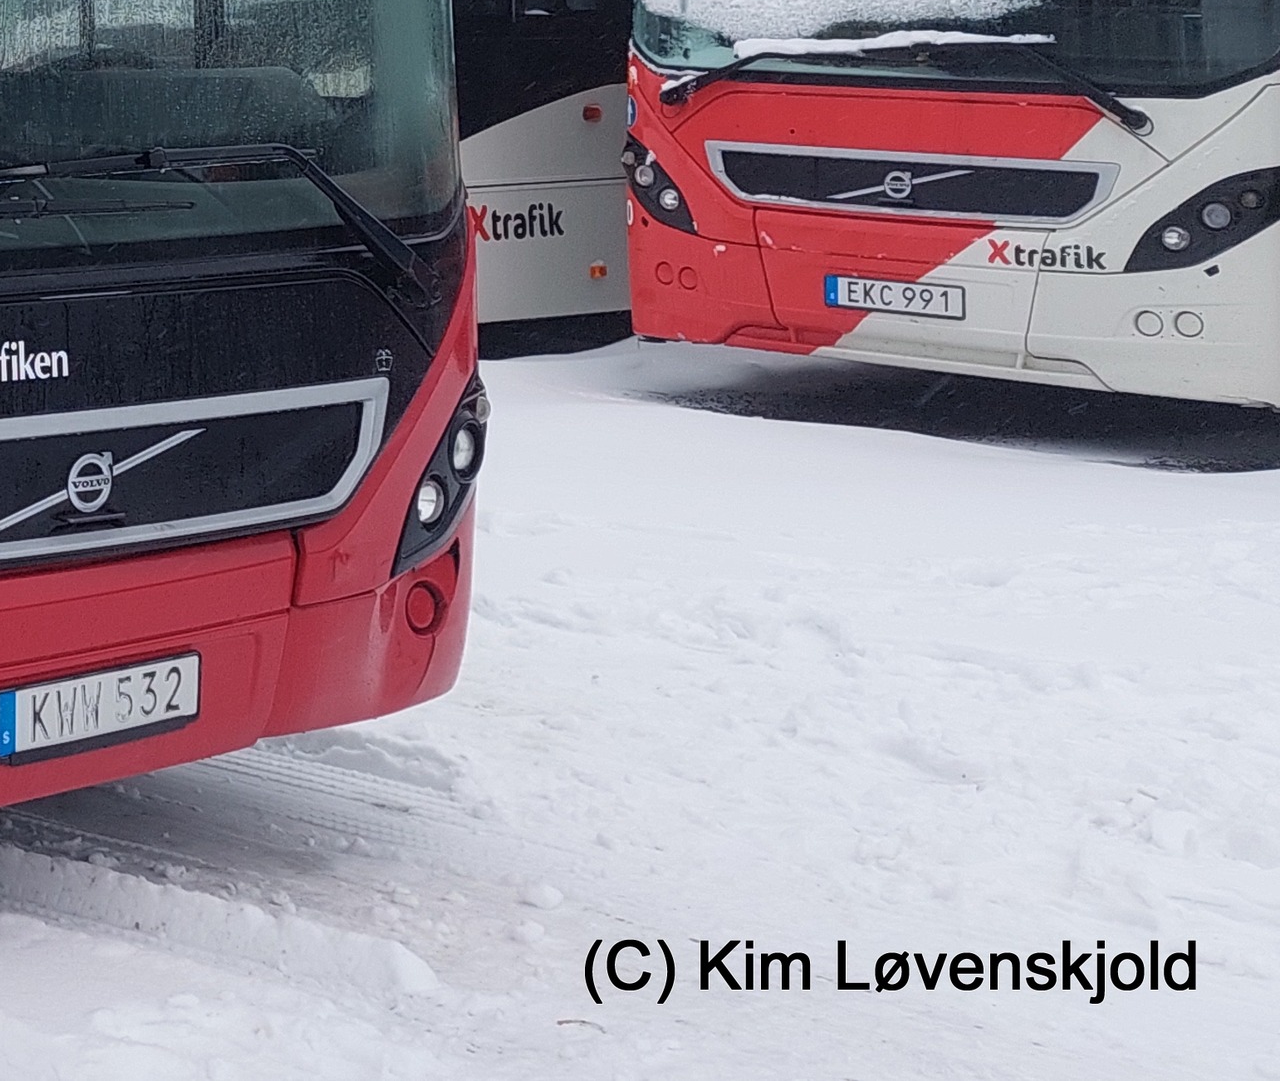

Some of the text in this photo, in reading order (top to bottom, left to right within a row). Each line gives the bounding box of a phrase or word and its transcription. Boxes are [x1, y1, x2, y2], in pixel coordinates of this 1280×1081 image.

[468, 202, 565, 241] Xtrafik
[987, 238, 1108, 270] Xtrafik
[847, 281, 950, 313] EKC 991
[71, 477, 111, 490] VOLVO
[30, 665, 182, 743] KWW 532
